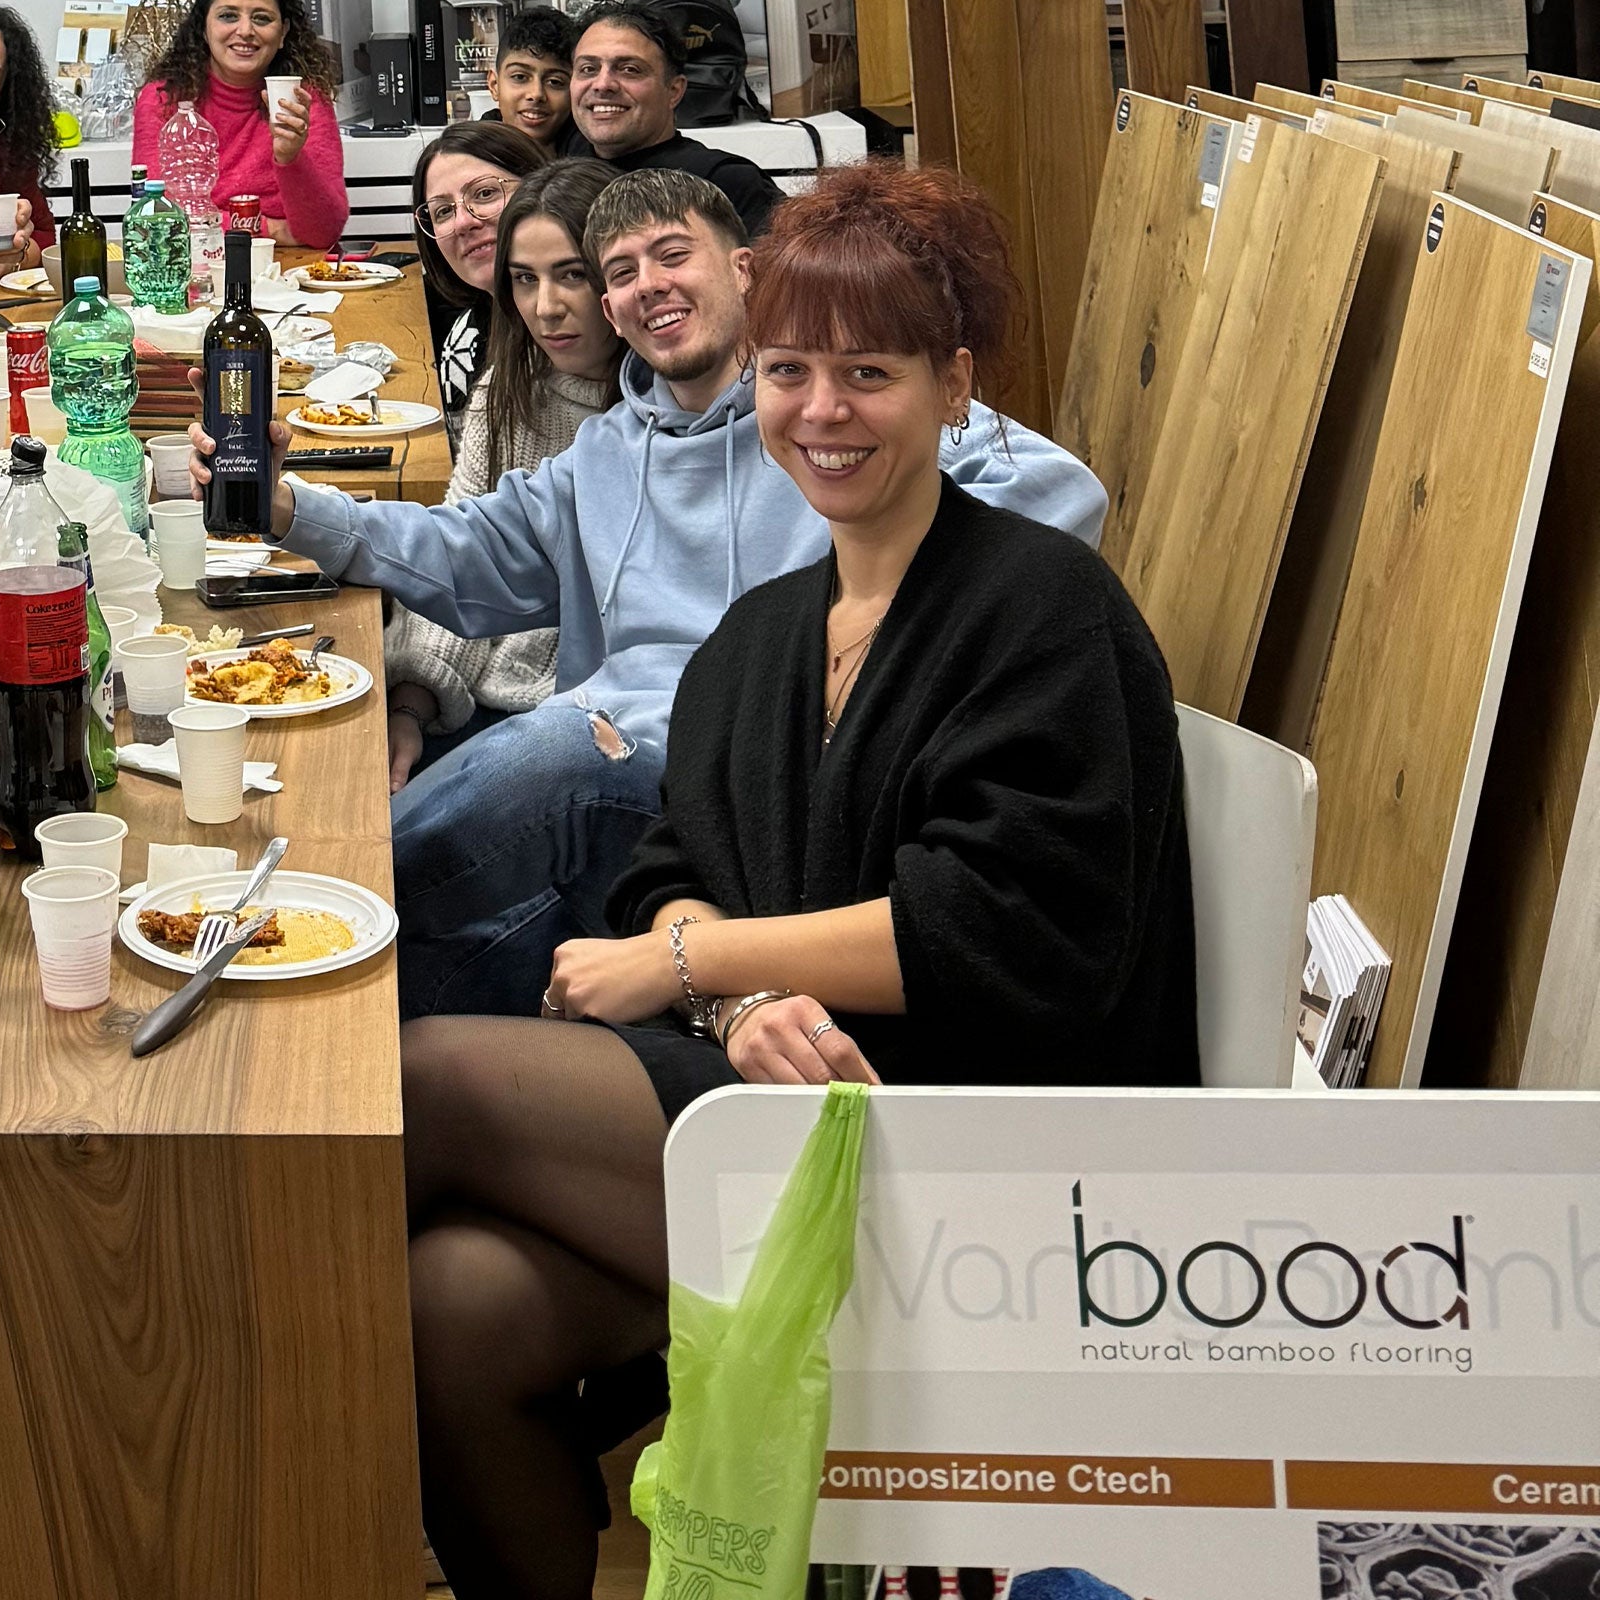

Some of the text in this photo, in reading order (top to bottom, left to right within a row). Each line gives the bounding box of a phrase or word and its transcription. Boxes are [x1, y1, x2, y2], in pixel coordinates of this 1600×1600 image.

[457, 45, 496, 59] LYME
[1080, 1339, 1474, 1374] natural bamboo flooring
[820, 1462, 1172, 1497] omposizione Ctech
